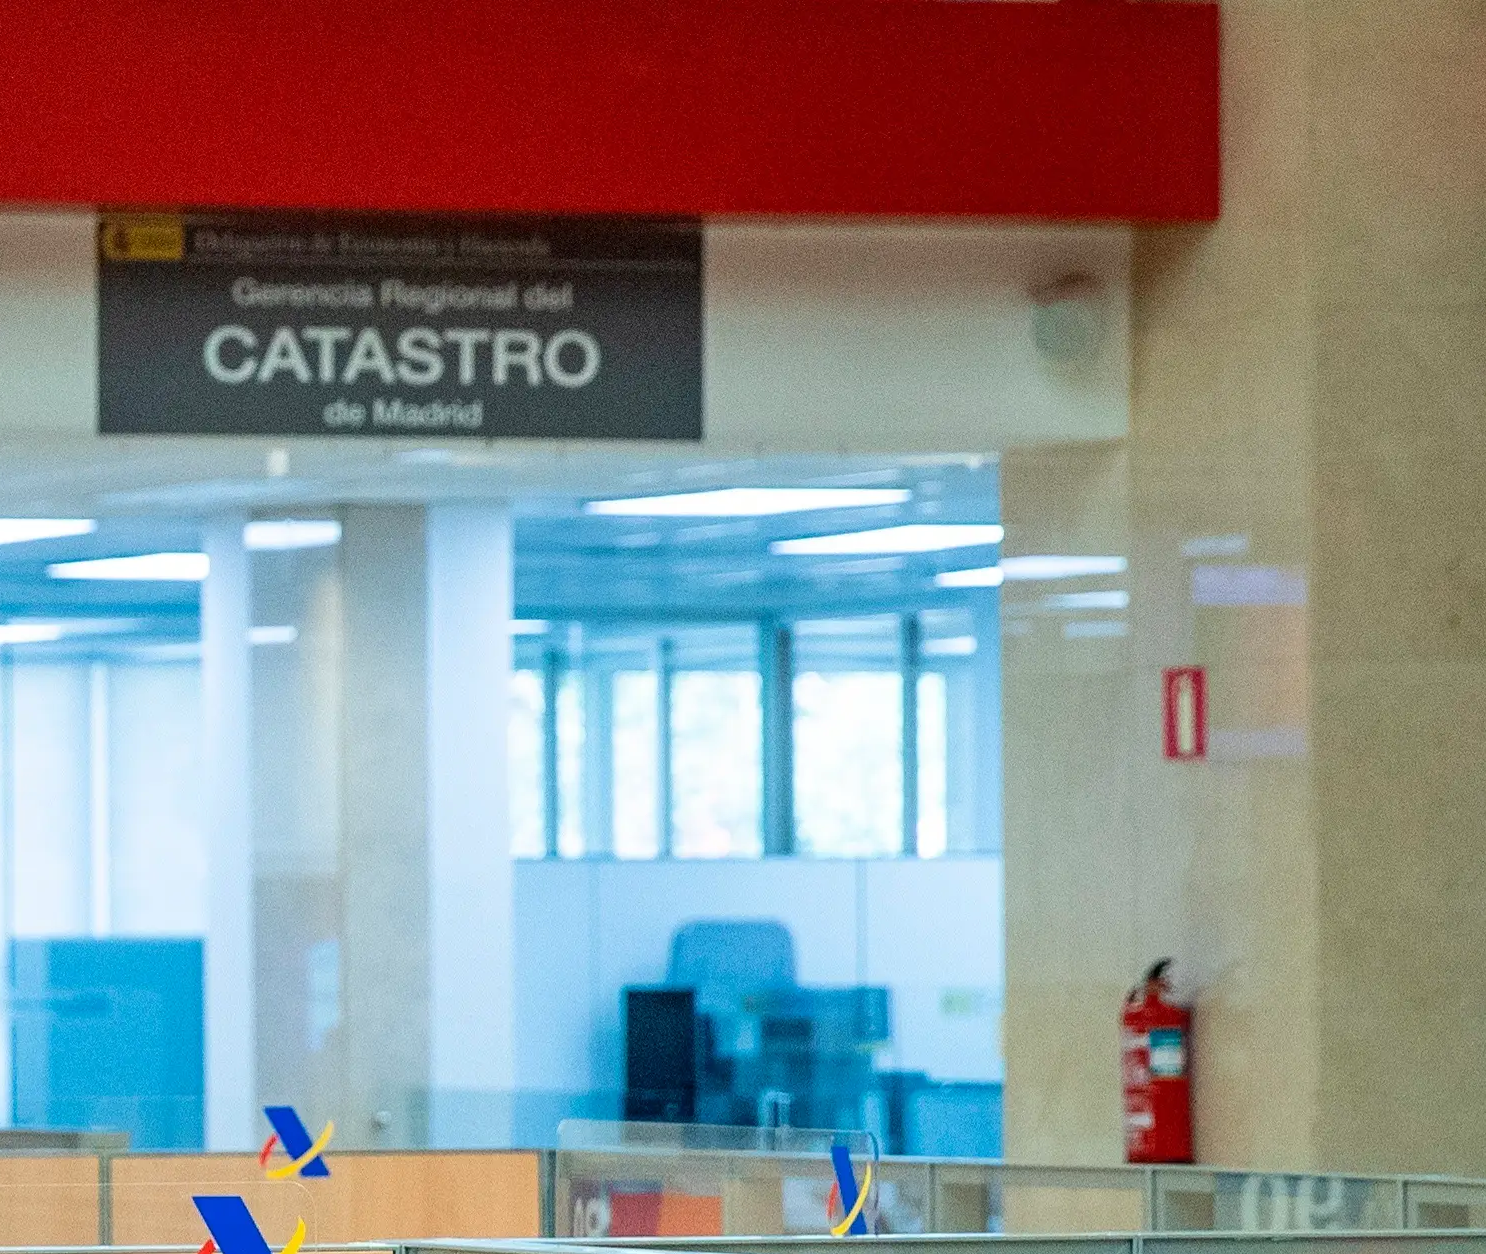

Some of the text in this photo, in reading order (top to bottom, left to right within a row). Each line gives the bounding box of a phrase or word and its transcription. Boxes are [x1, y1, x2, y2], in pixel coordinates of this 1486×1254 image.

[232, 277, 574, 313] Gerencia Regional del
[203, 325, 602, 388] CATASTRO
[323, 400, 484, 429] de Madrid
